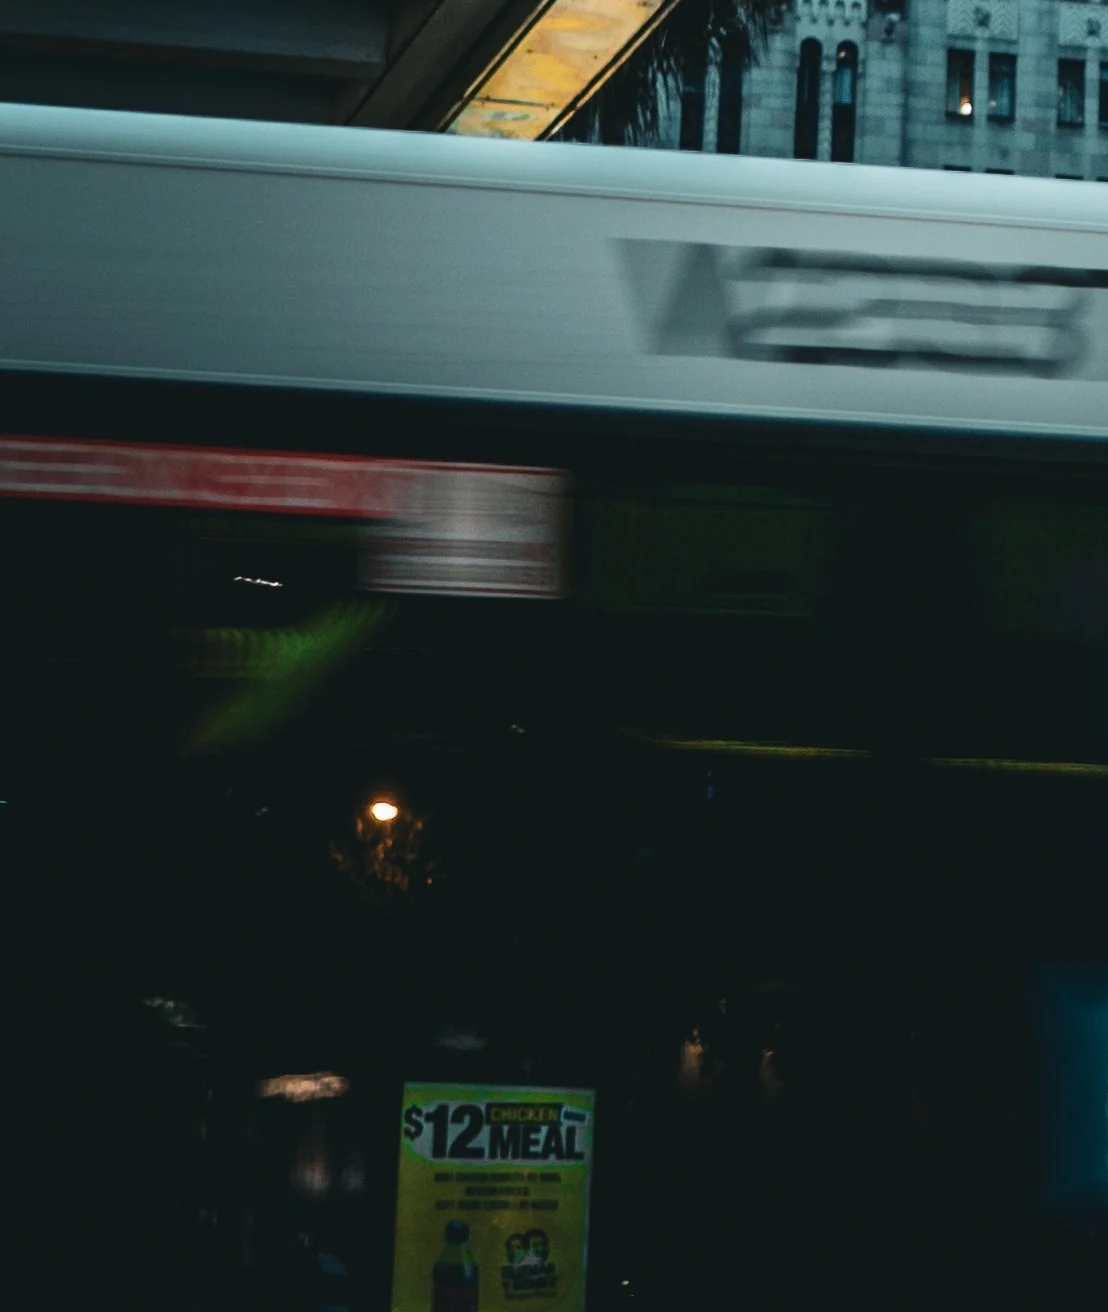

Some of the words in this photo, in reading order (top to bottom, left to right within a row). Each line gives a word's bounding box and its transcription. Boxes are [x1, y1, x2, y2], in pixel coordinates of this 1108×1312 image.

[404, 1102, 486, 1160] $12
[489, 1106, 558, 1122] CHICKEN
[488, 1124, 585, 1161] MEAL
